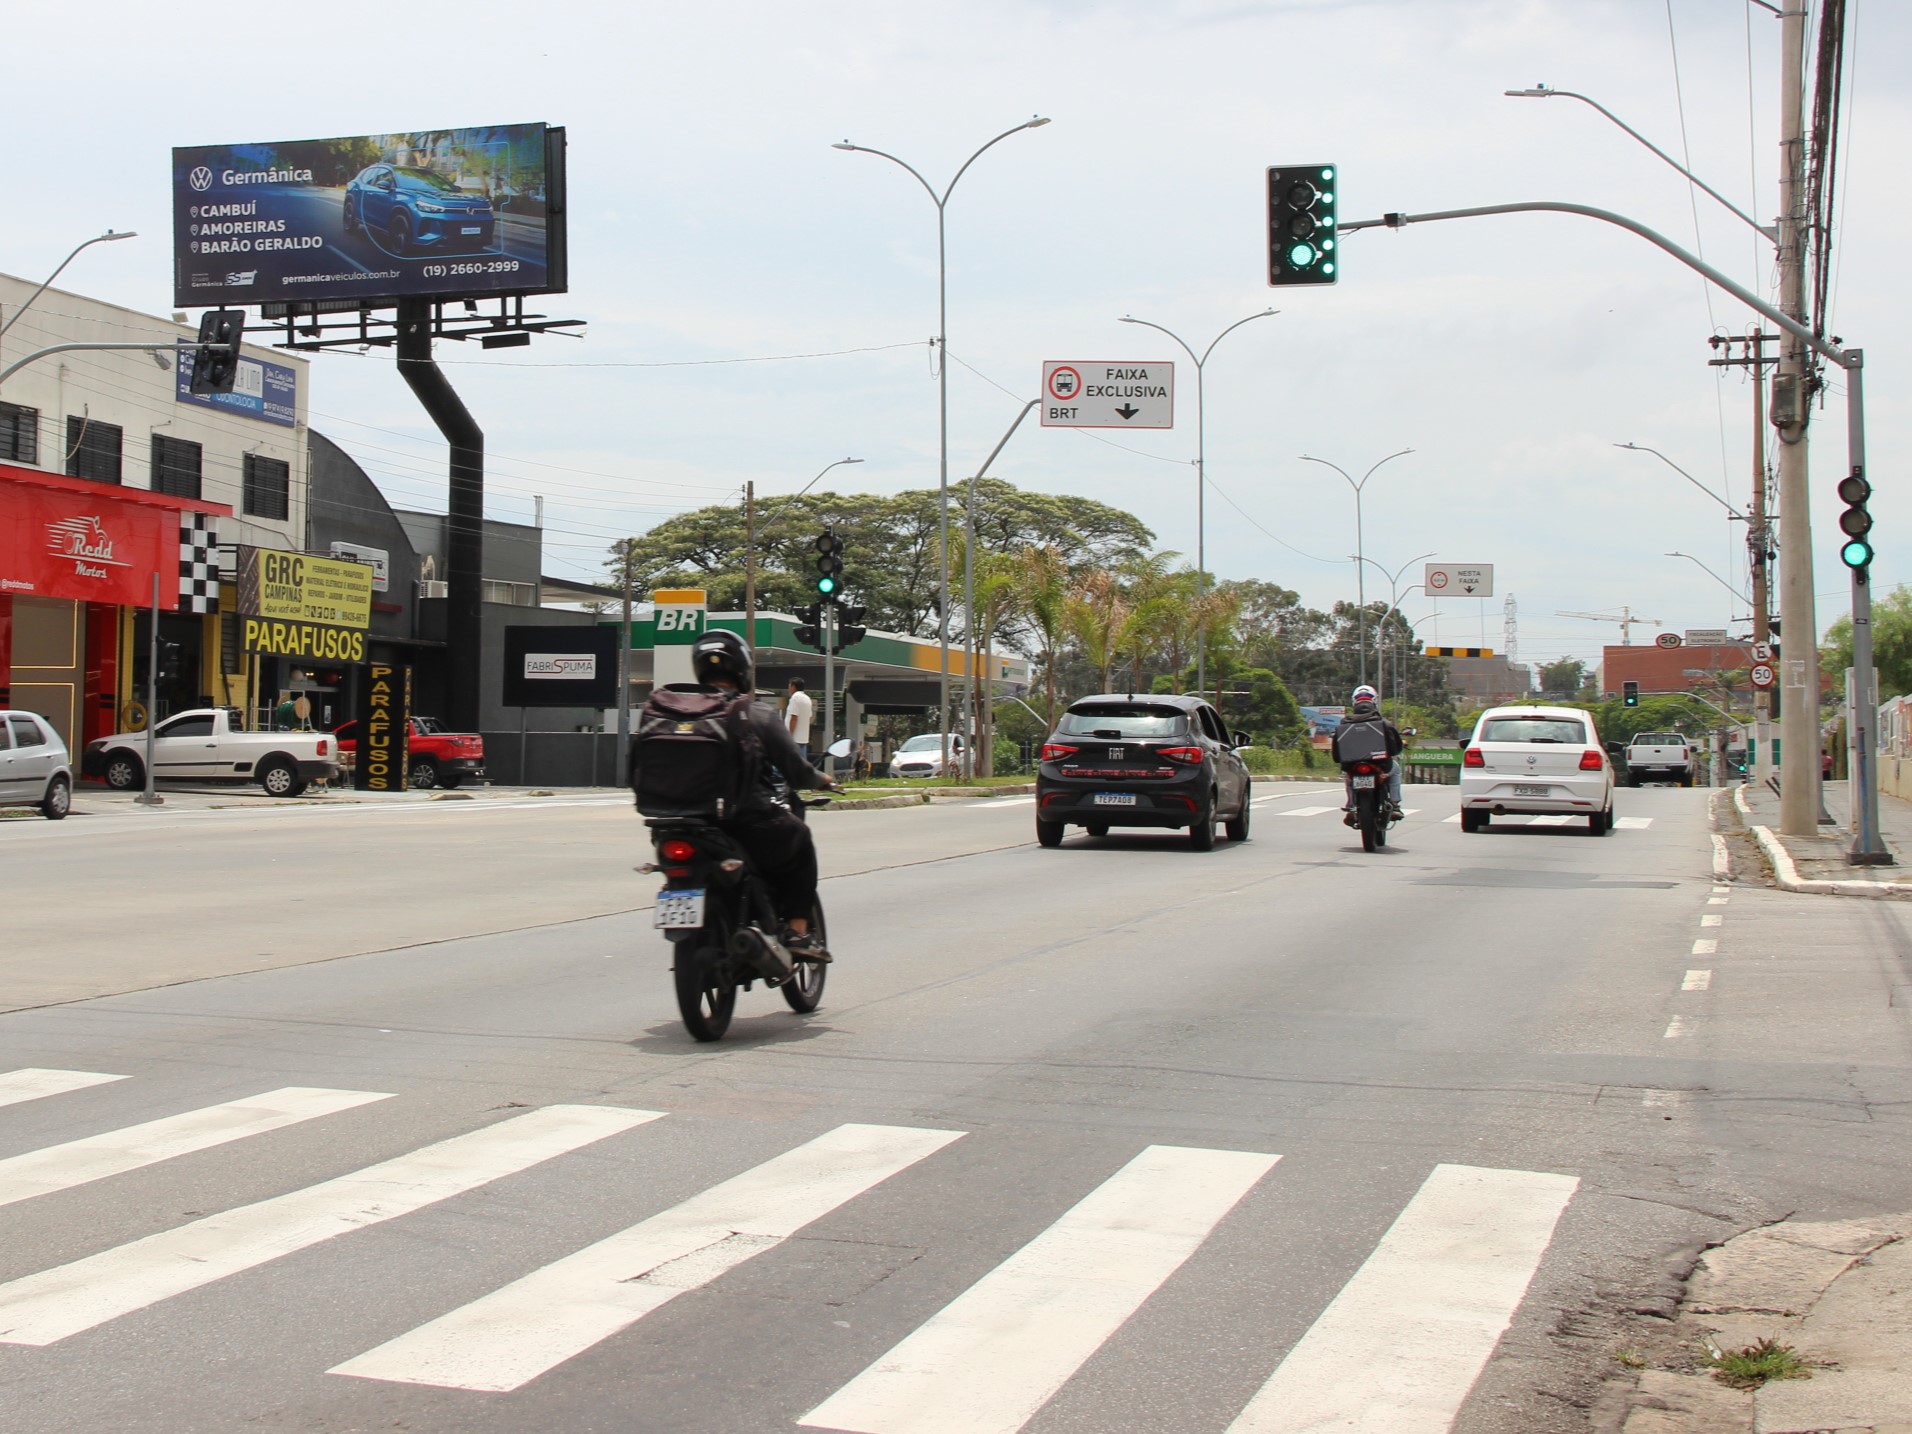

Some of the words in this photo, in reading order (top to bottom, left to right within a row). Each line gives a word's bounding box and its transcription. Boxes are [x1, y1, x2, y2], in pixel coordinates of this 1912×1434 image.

[222, 165, 313, 186] Germânica
[200, 200, 257, 218] CAMBUÍ
[200, 220, 286, 236] AMOREIRAS
[201, 237, 251, 254] BARÃO
[254, 236, 323, 251] GERALDO
[282, 269, 400, 285] germanicaveiculos.com.br
[423, 264, 447, 278] (19)
[450, 260, 520, 275] 2660-2999
[1106, 368, 1148, 380] FAIXA
[1086, 385, 1167, 398] EXCLUSIVA
[1049, 407, 1079, 419] BRT
[73, 532, 113, 559] Redd
[75, 561, 108, 579] Motos
[265, 553, 304, 587] GRC
[264, 584, 303, 603] CAMPINAS
[656, 609, 698, 631] BR
[245, 619, 363, 661] PARAFUSOS
[1661, 636, 1676, 644] 50
[527, 658, 593, 674] FABRISPUMA
[1754, 669, 1771, 680] 50
[368, 667, 393, 789] PARAFUSOS
[401, 667, 412, 790] PARAFUSOS
[1108, 747, 1125, 760] FIAT
